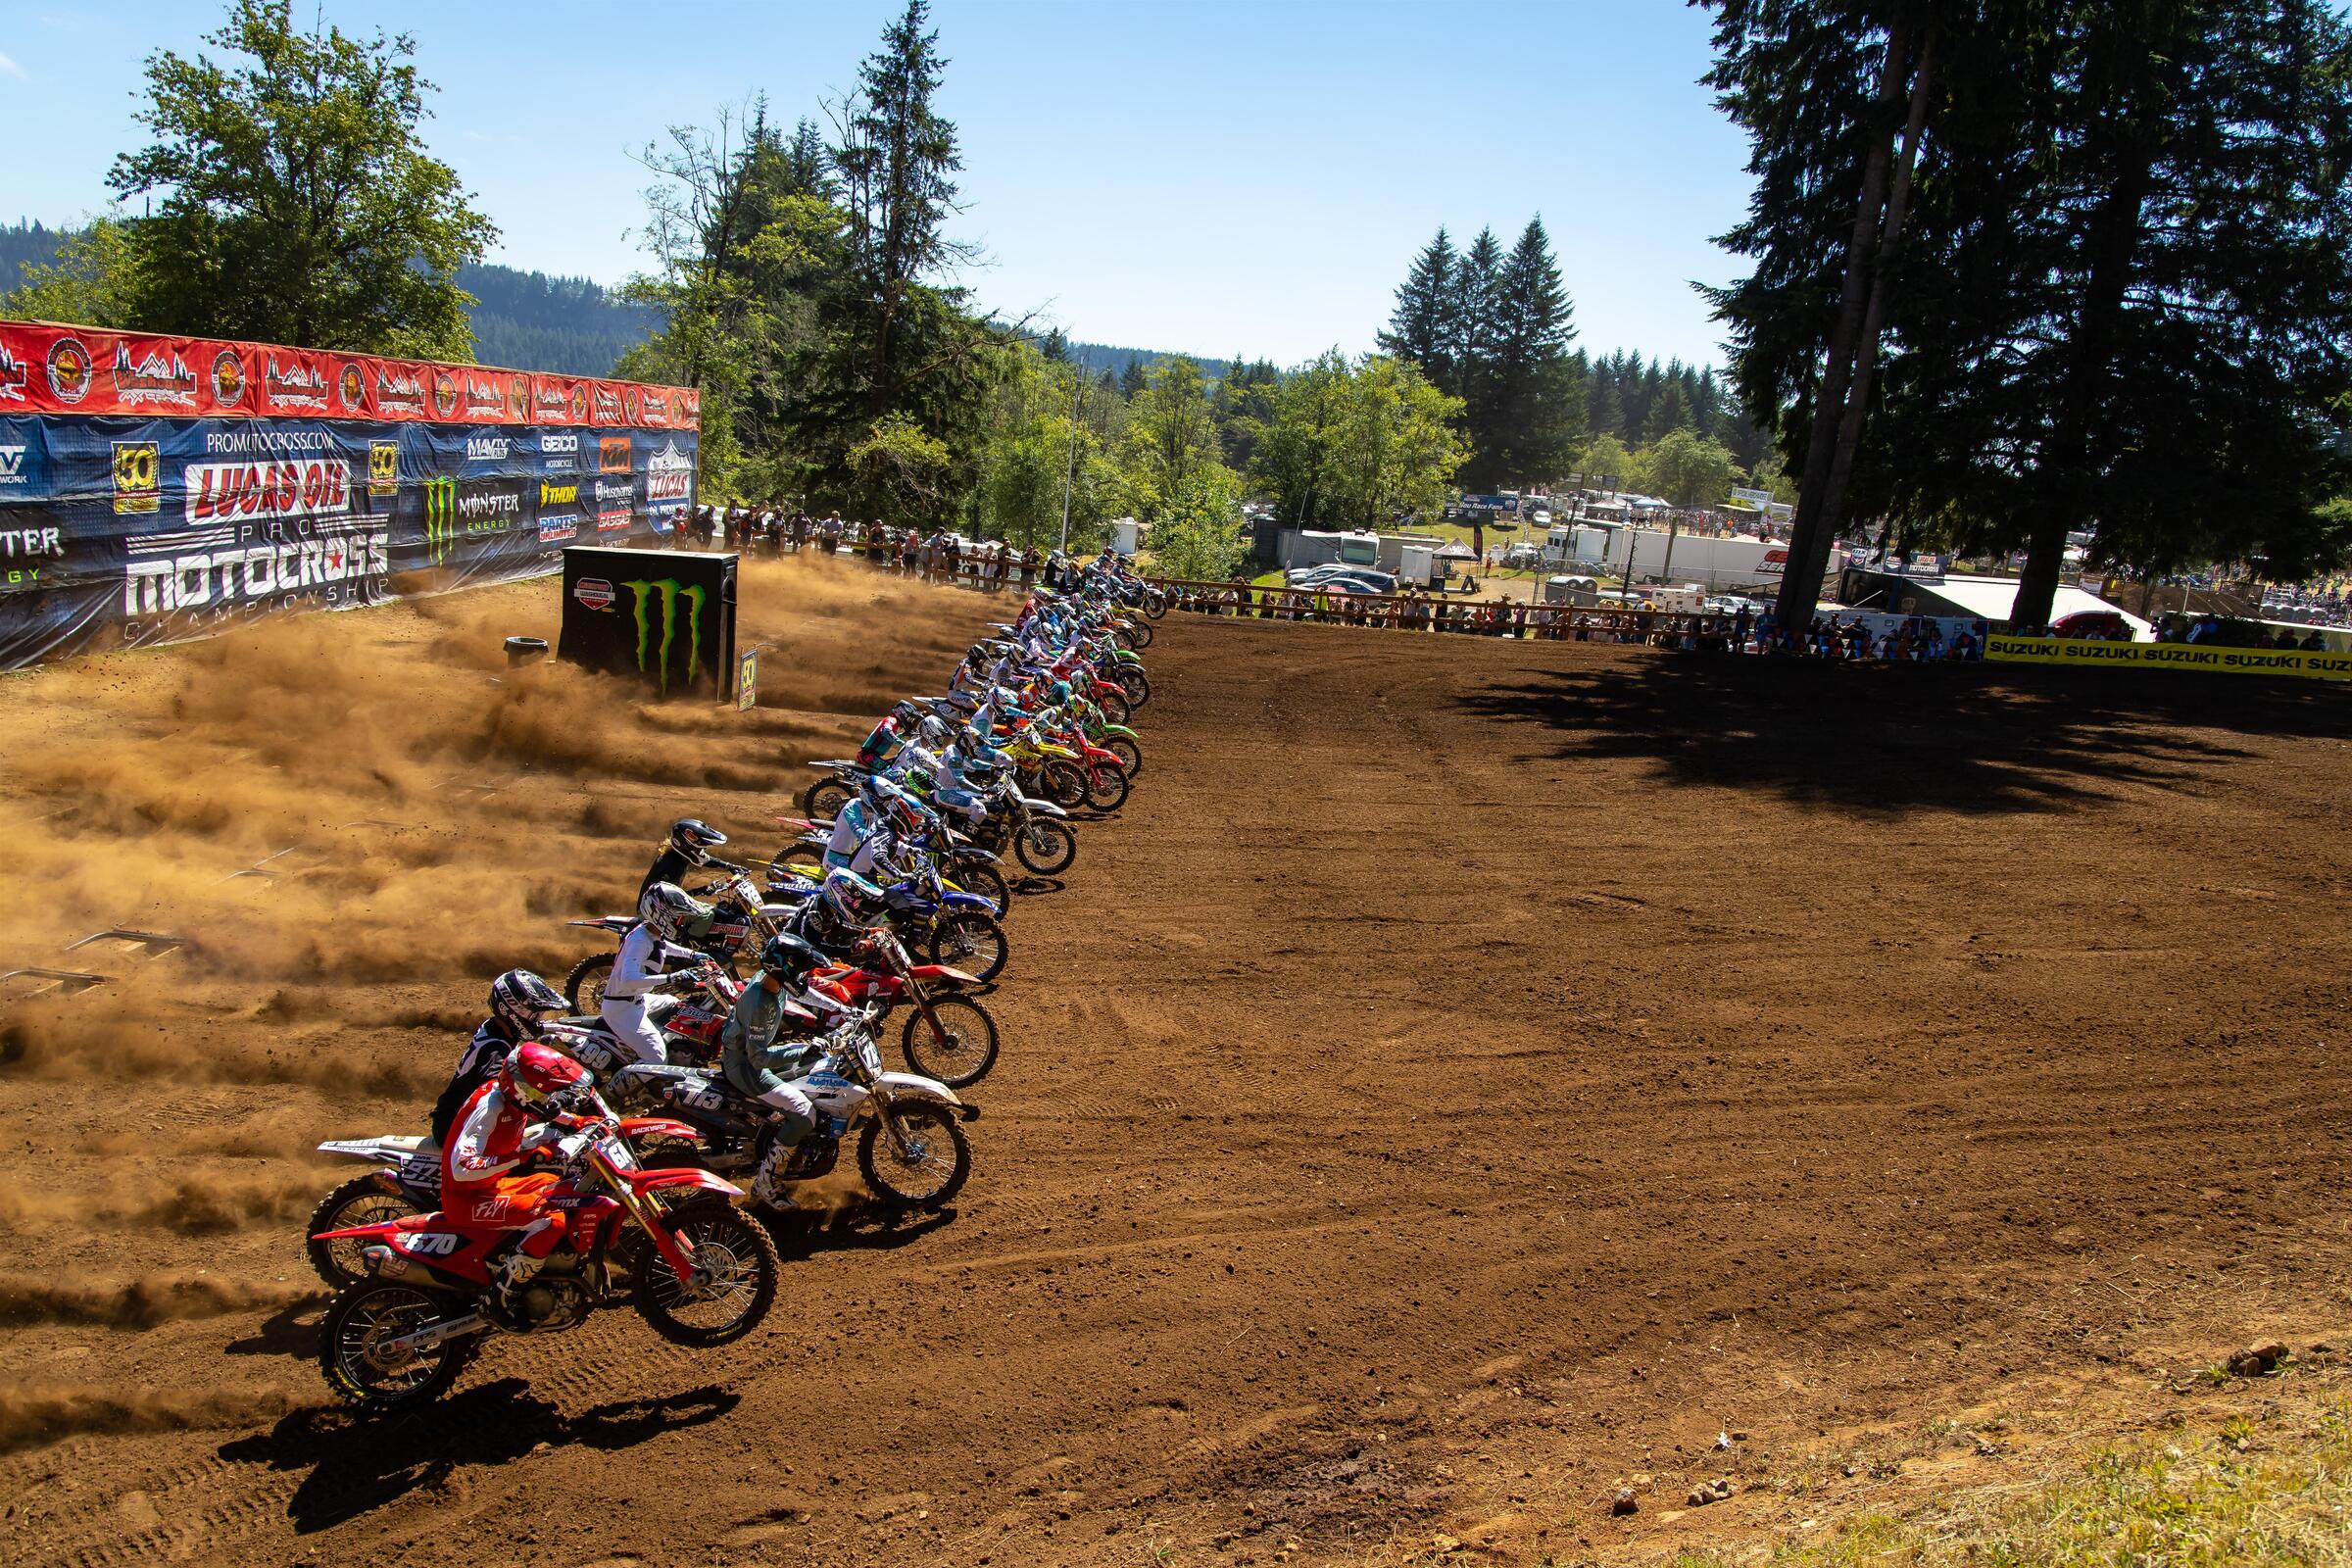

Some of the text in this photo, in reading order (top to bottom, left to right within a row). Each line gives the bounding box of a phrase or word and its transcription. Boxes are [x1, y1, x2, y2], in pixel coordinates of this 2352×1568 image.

[541, 435, 578, 452] GEICO
[121, 449, 154, 487] 50
[371, 446, 392, 476] 50
[194, 463, 347, 518] LUCAS OIL
[549, 485, 577, 504] THOR
[652, 475, 688, 499] LUCAS
[459, 492, 520, 518] MONSTER
[1472, 502, 1487, 511] Race
[241, 519, 311, 542] PRO
[467, 519, 511, 531] ENERGY
[540, 515, 577, 533] PARTS
[8, 568, 40, 583] GY
[125, 533, 389, 615] MOTOCROSS
[124, 578, 389, 640] CHAMPIONSHIP
[1989, 641, 2058, 656] SUZUKI
[2065, 645, 2138, 660] SUZUKI
[2143, 649, 2219, 664] SUZUKI
[2225, 654, 2301, 668] SUZUKI
[631, 1124, 666, 1135] BACKYARD
[475, 1199, 506, 1218] FLY
